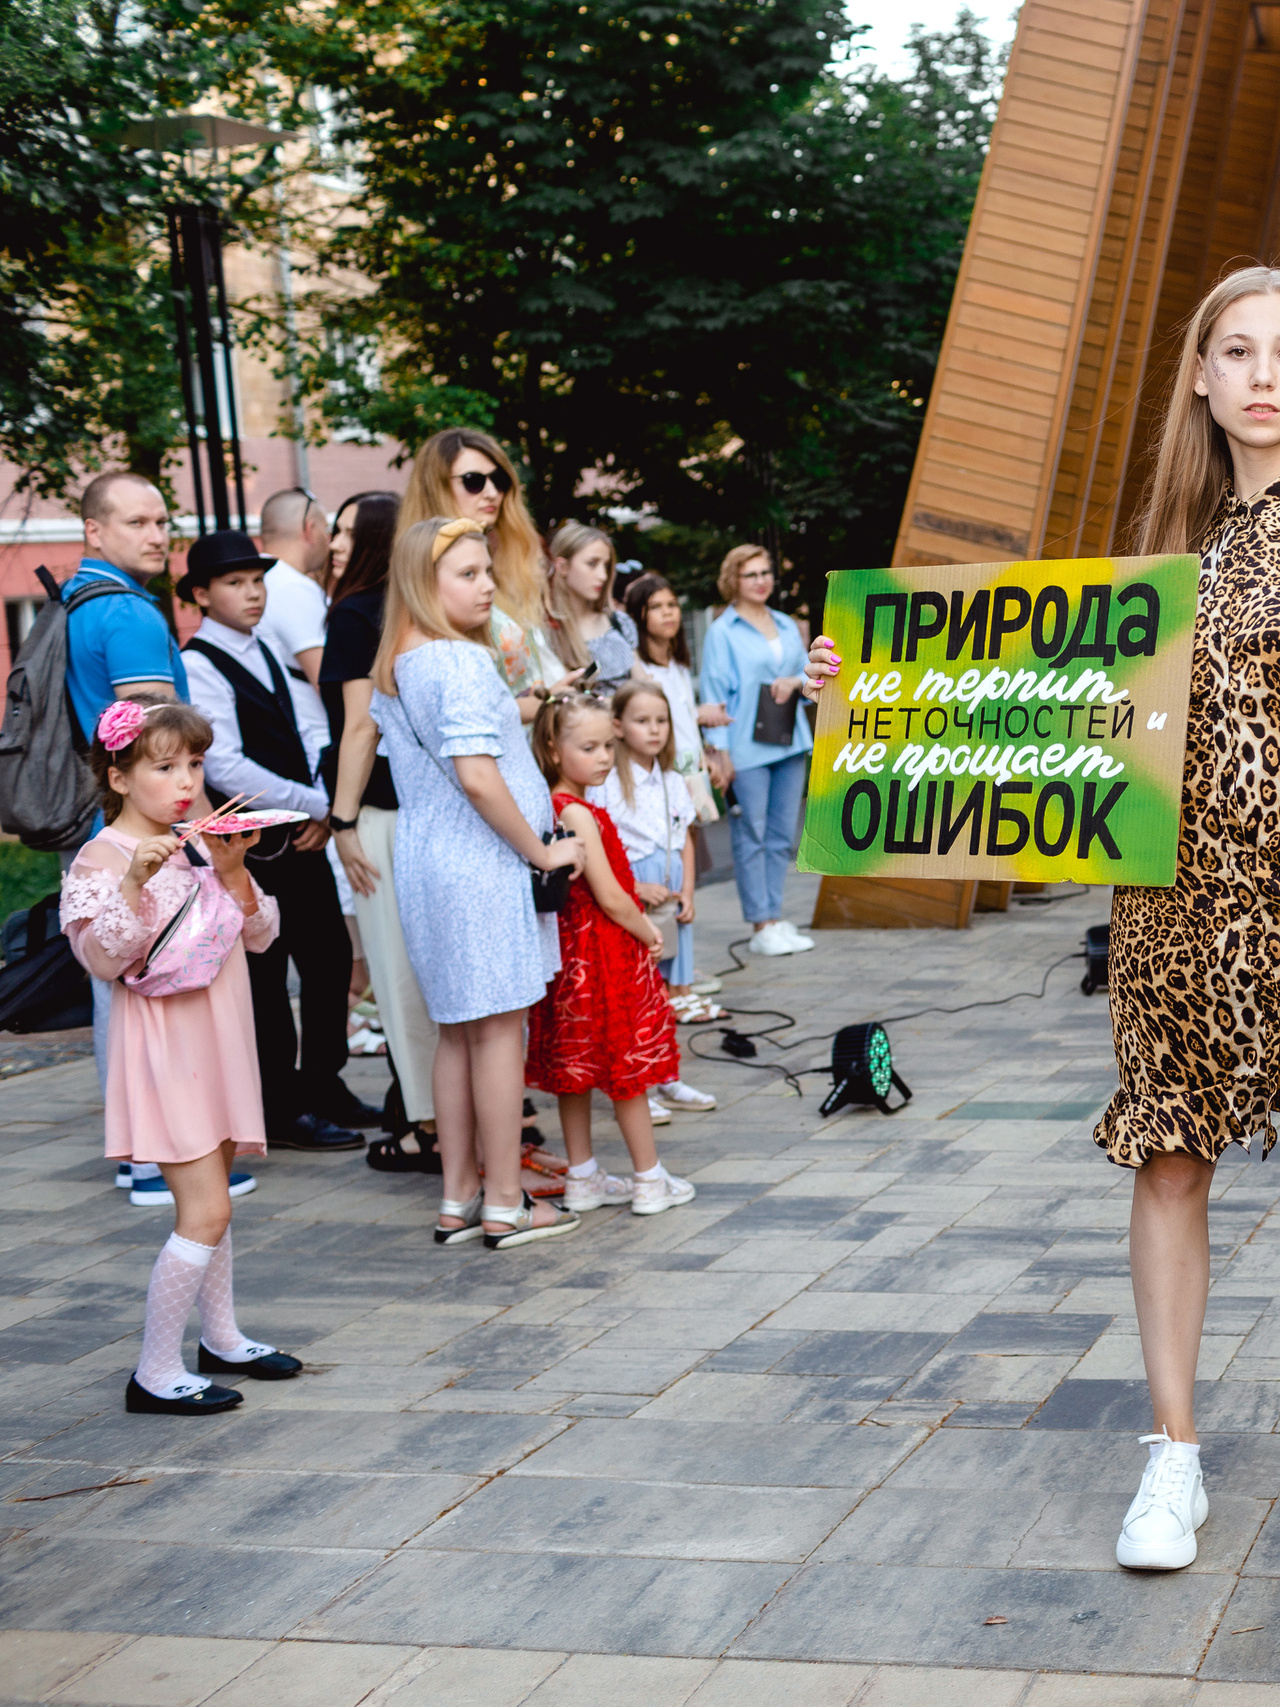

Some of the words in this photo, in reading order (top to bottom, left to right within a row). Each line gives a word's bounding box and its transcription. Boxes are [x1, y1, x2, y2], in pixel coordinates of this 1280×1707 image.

[848, 669, 903, 702] не
[913, 666, 1129, 714] терпит
[847, 699, 1135, 739] НЕТОЧНОСТЕЙ
[832, 740, 885, 773] не
[892, 742, 1125, 791] прощает
[840, 778, 1130, 860] ОШИБОК
